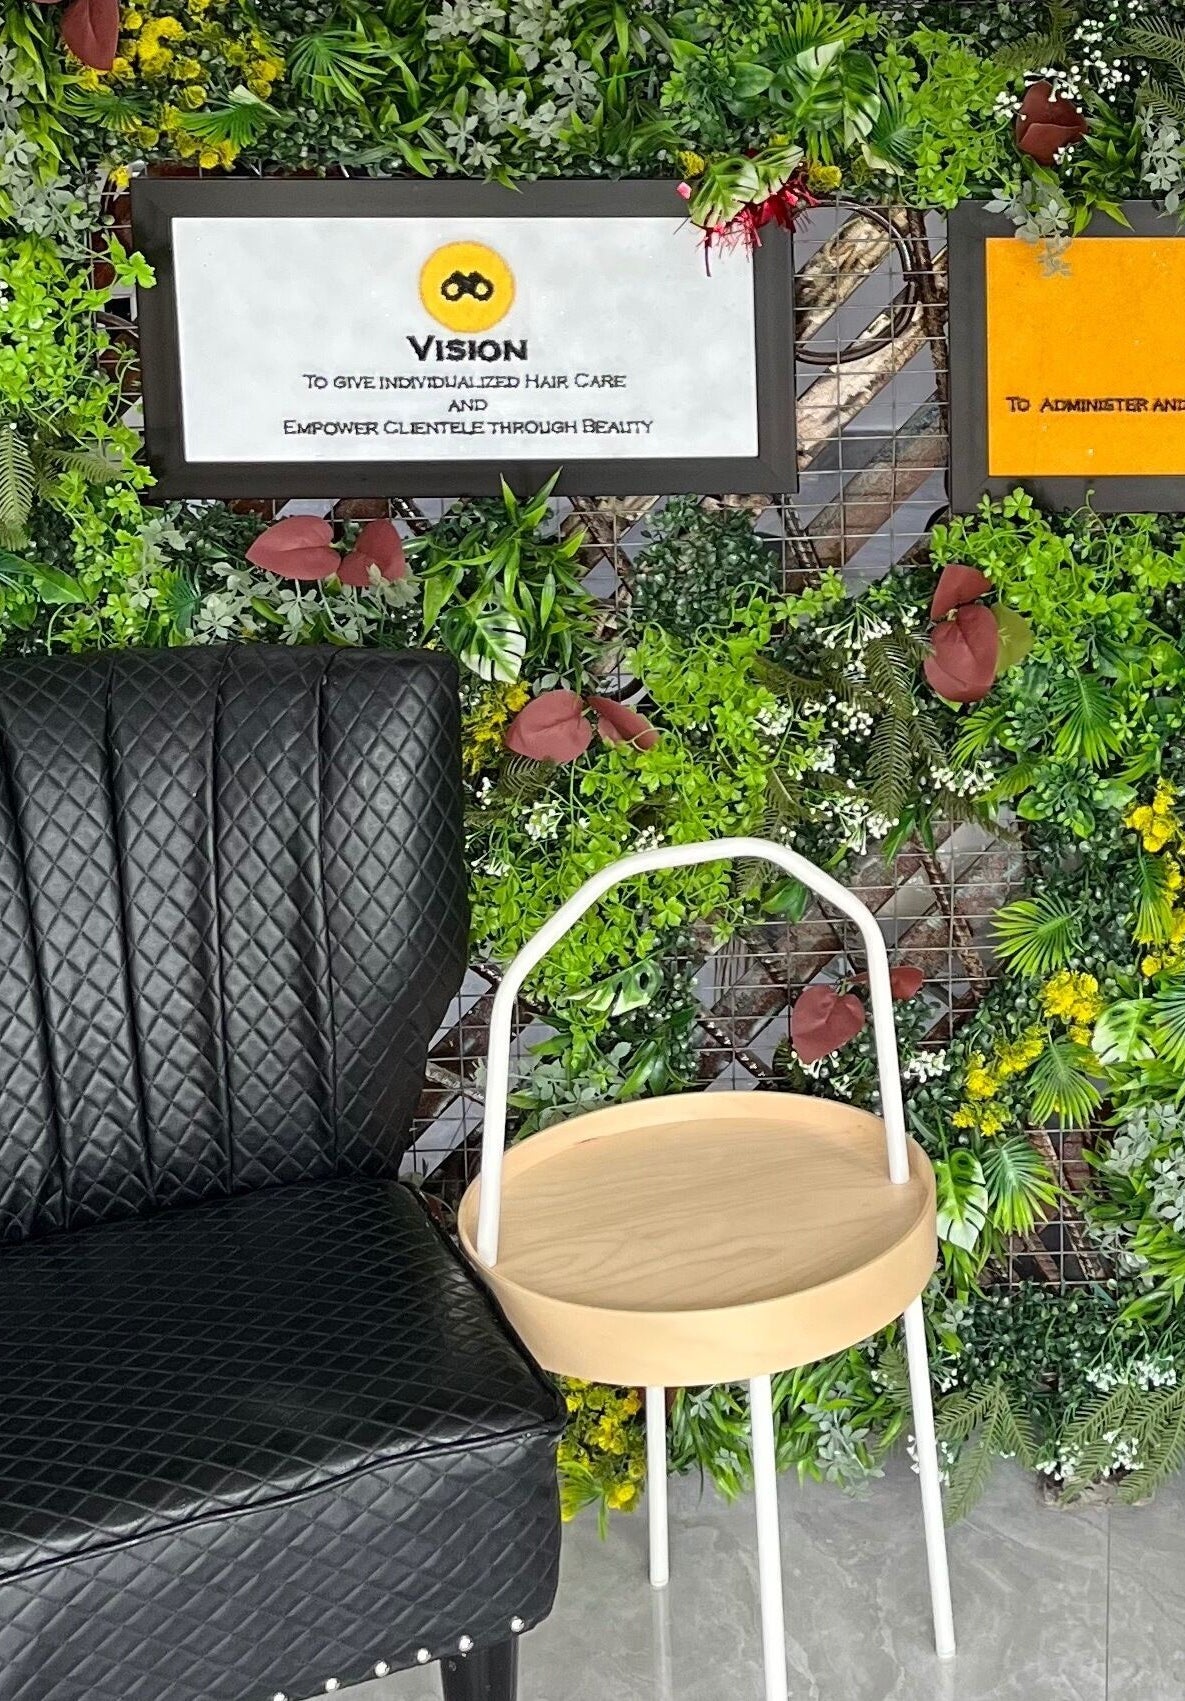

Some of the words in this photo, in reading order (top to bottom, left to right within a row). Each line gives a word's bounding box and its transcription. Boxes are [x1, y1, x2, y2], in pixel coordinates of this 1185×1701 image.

[406, 335, 528, 362] VISION
[302, 374, 328, 389] TO
[333, 375, 375, 389] GIVE
[379, 374, 520, 389] INDIVIDUALIZED
[525, 374, 569, 389] HAIR
[574, 373, 627, 388] CARE
[448, 399, 488, 412] AND
[1006, 396, 1031, 412] TO
[1040, 397, 1148, 413] ADMINISTER
[283, 420, 379, 435] EMPOWER
[383, 419, 484, 435] CLIENTELE
[487, 420, 578, 434] THROUGH
[582, 418, 653, 434] BEAUTY
